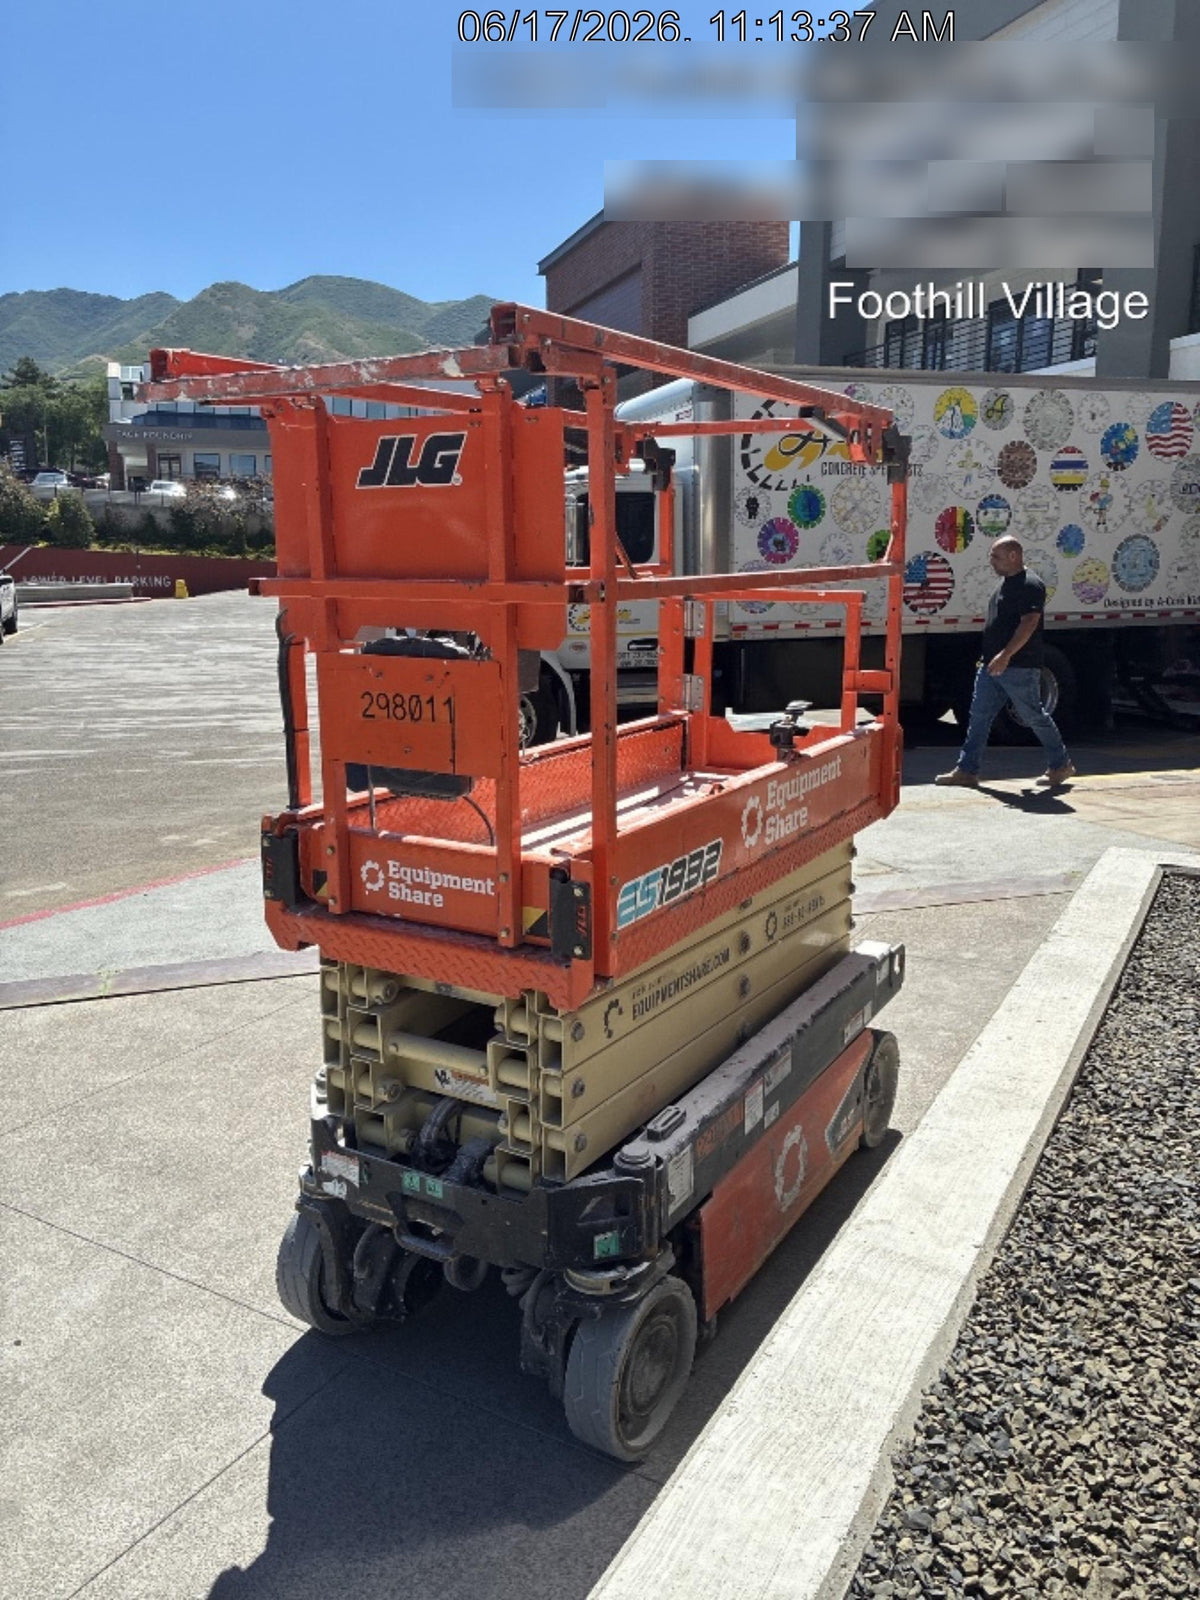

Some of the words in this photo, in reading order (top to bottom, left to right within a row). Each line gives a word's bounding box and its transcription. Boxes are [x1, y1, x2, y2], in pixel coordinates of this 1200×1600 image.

[355, 430, 468, 489] JLG
[115, 575, 172, 588] PARKING
[360, 690, 453, 724] 298011
[765, 755, 842, 811] Equipment
[765, 806, 808, 845] Share
[387, 860, 495, 896] Equipment
[388, 881, 444, 907] Share
[617, 837, 723, 930] ES1932
[632, 947, 730, 1020] EQUIPMENTSHARE.COM
